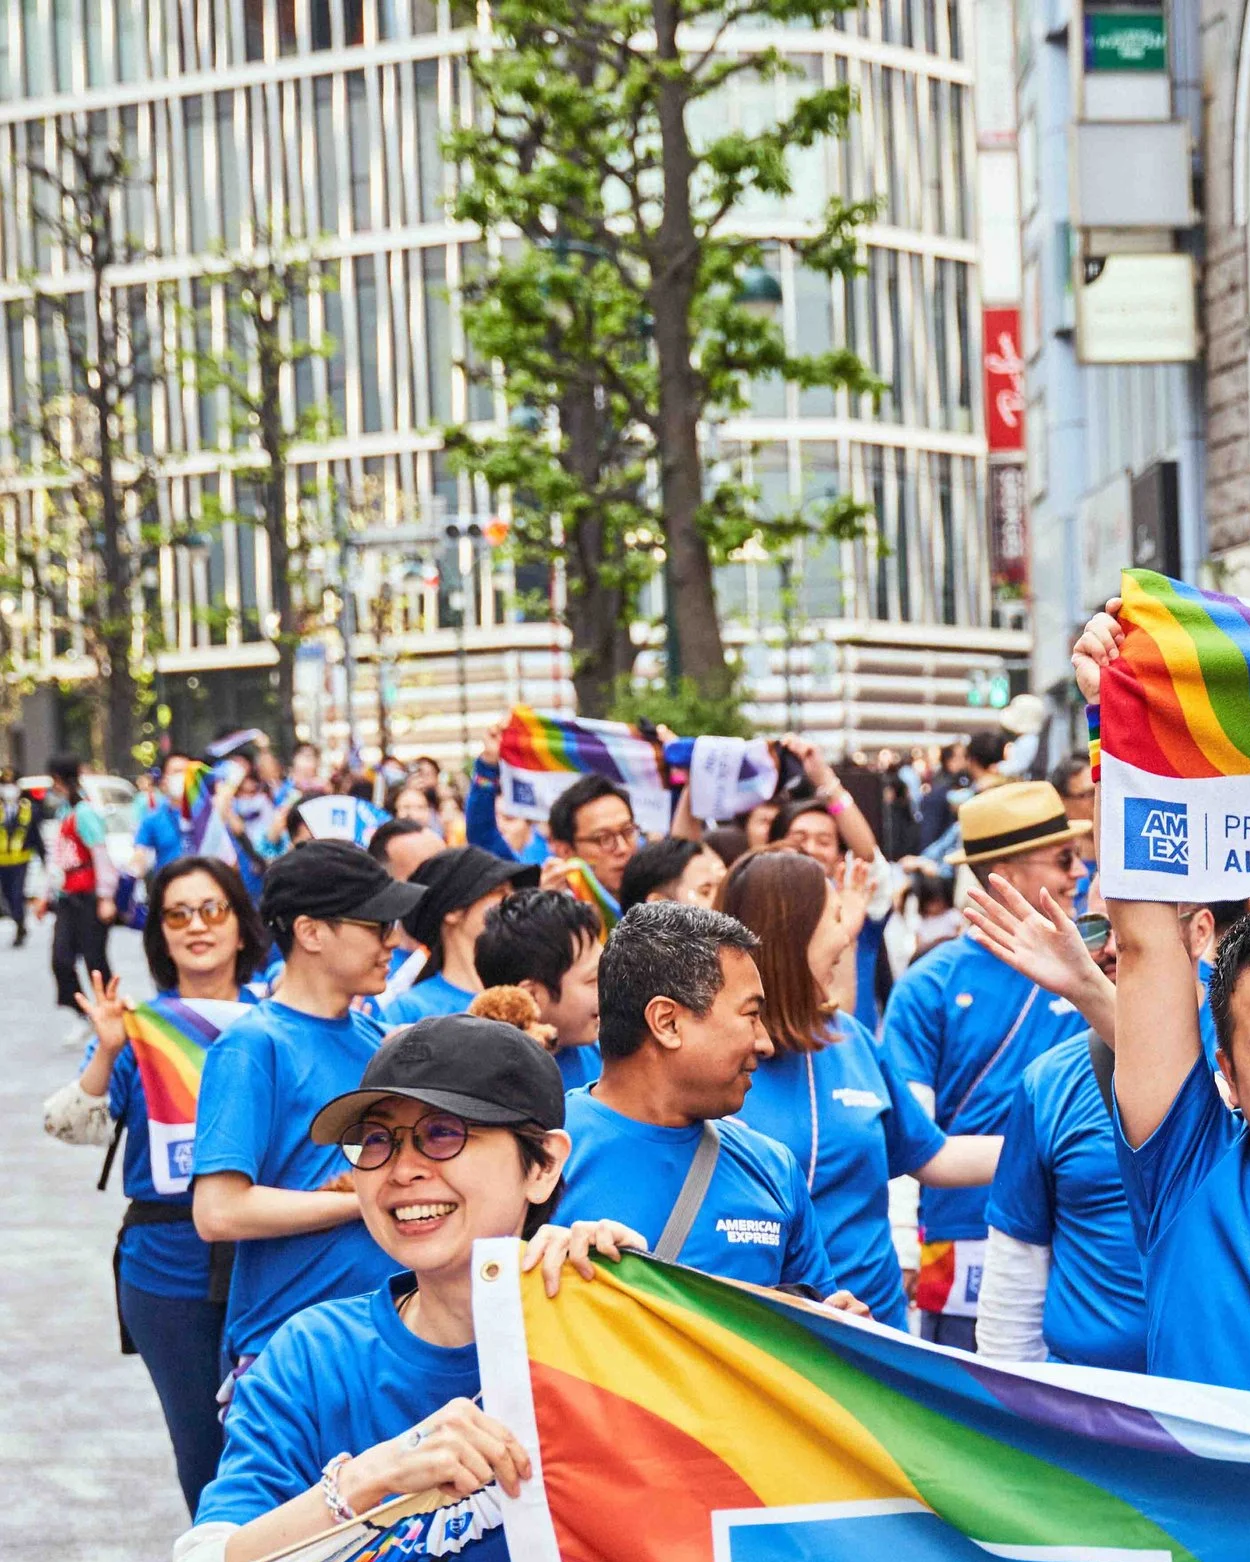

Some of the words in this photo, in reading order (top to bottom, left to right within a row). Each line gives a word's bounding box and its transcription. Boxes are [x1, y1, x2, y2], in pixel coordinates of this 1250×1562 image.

[1141, 809, 1188, 838] AM
[1148, 836, 1188, 866] EX
[715, 1218, 781, 1234] AMERICAN
[727, 1231, 780, 1246] EXPRESS
